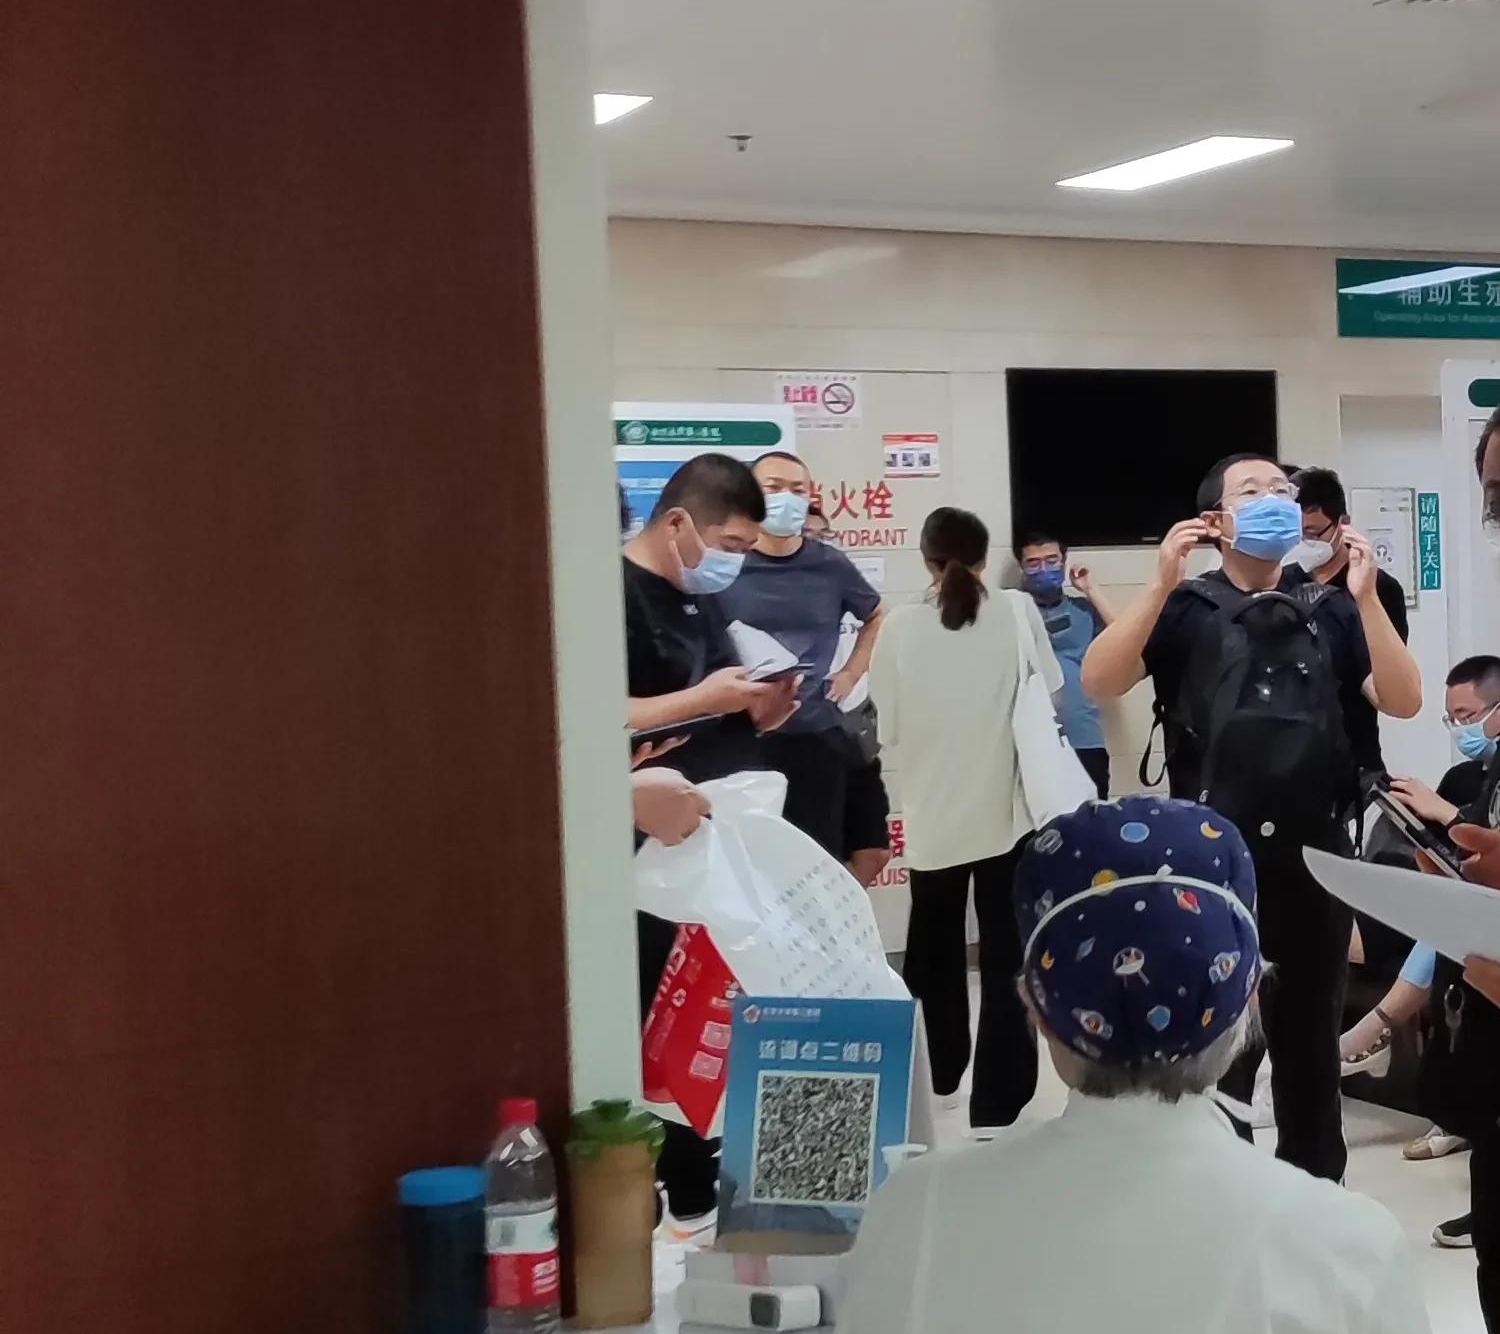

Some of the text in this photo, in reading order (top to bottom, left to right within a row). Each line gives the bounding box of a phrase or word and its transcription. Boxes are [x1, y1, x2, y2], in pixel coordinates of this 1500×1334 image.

[836, 528, 908, 547] YDRANT
[1420, 496, 1440, 588] 请随手关门
